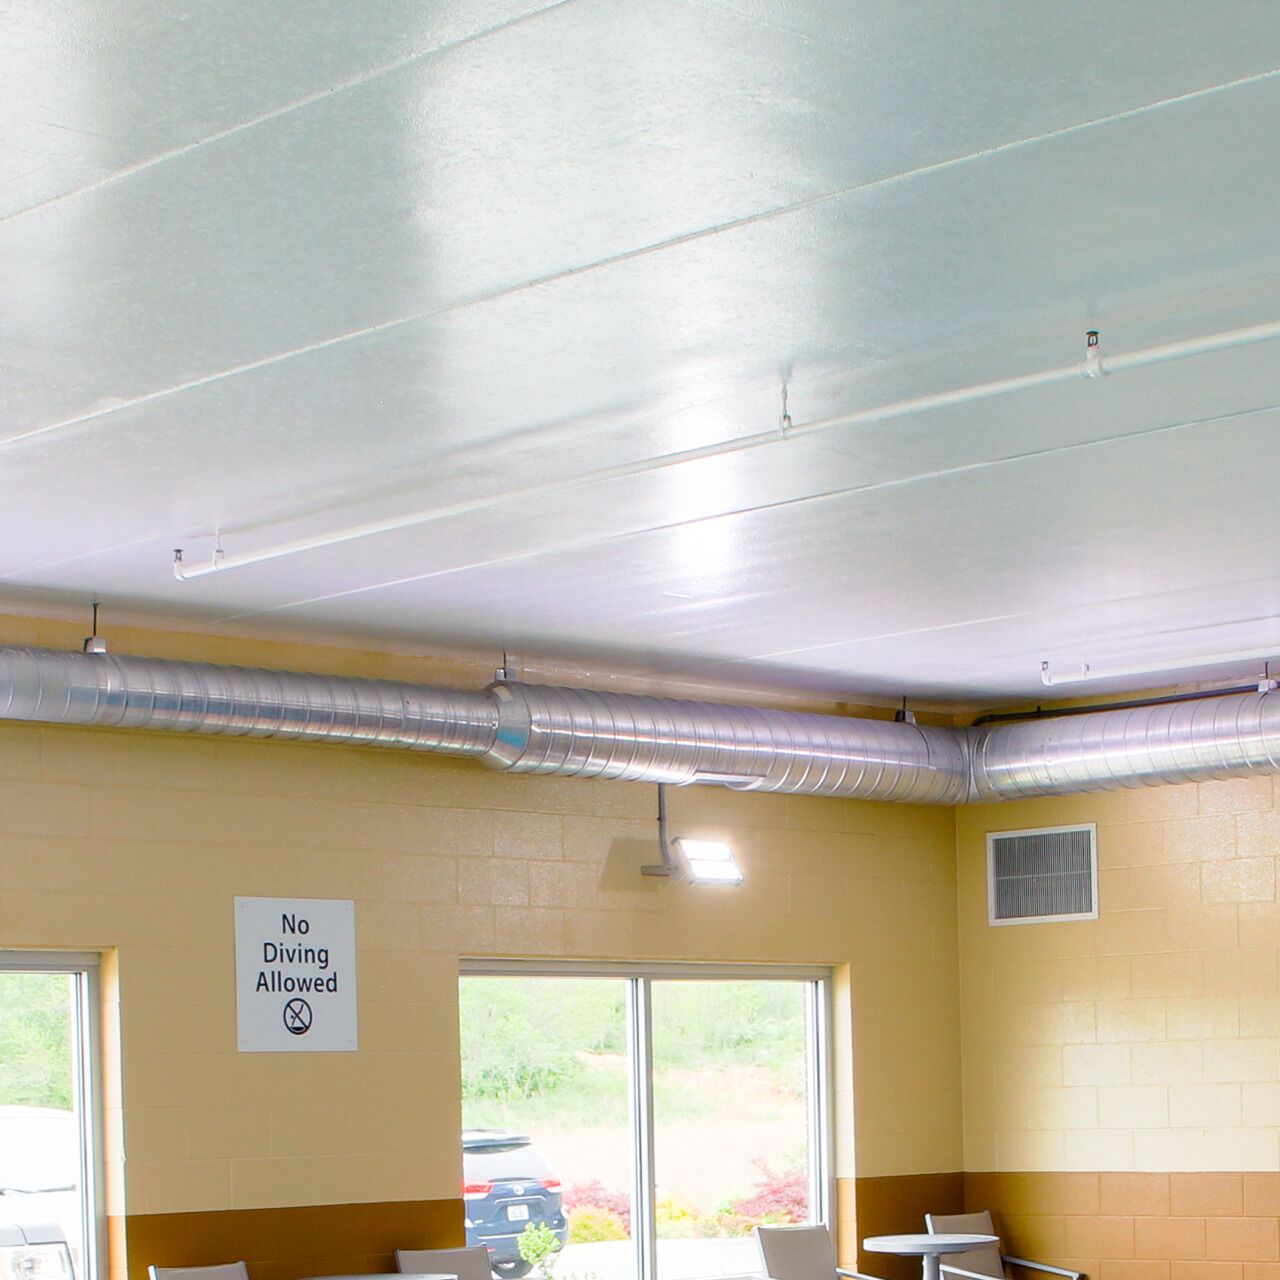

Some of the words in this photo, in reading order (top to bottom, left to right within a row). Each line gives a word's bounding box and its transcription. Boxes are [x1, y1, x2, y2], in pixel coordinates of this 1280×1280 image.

[281, 913, 310, 935] No
[263, 941, 329, 970] Diving
[255, 970, 338, 993] Allowed
